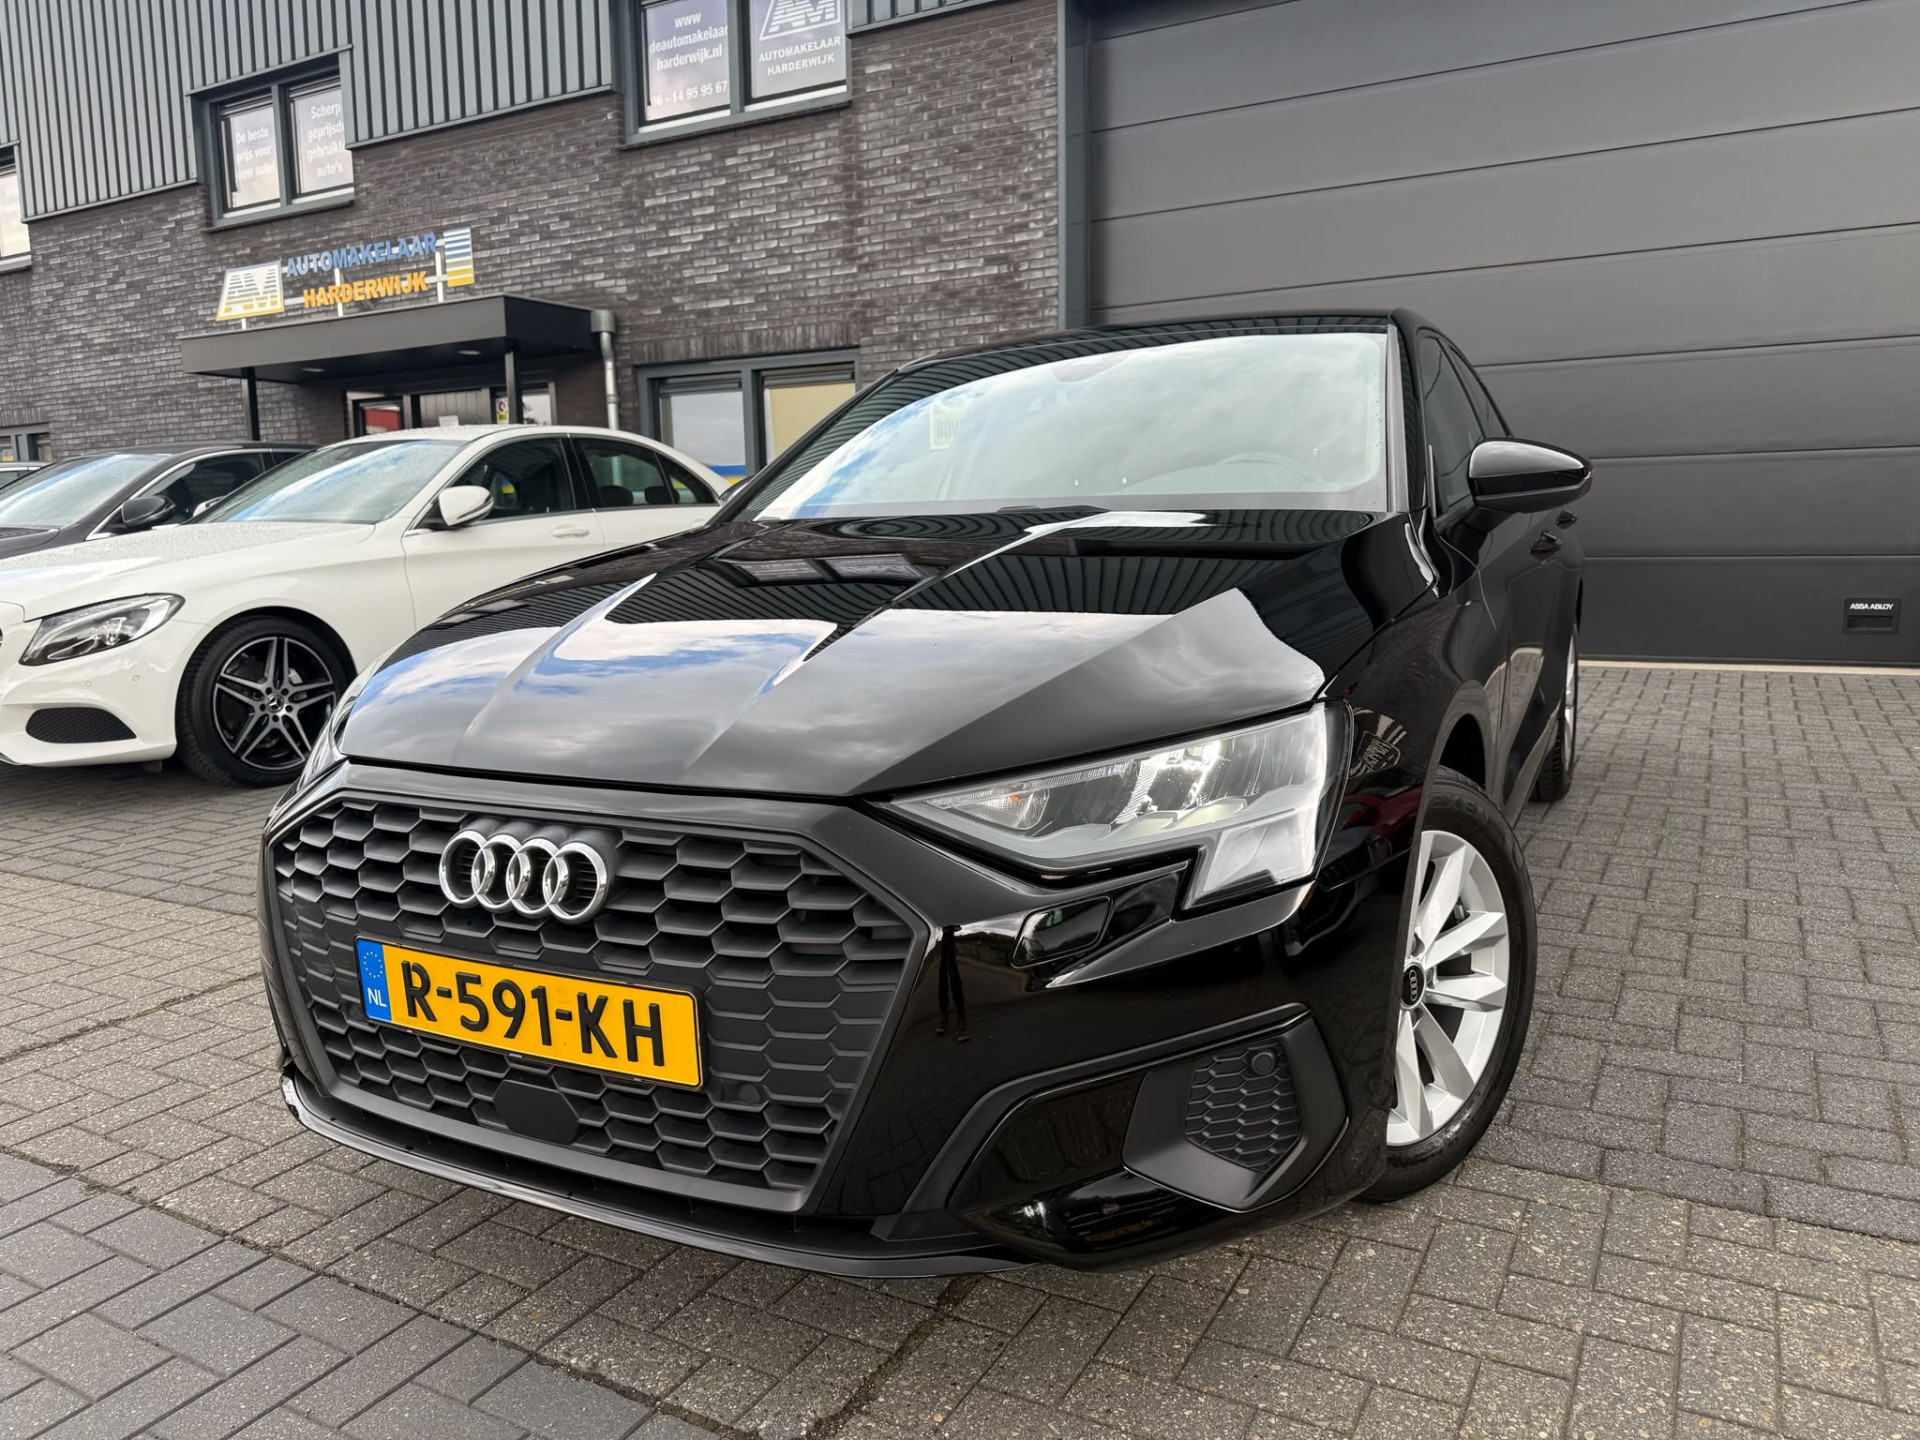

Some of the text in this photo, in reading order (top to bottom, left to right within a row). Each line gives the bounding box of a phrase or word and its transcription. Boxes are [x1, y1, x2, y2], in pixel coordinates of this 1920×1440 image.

[674, 12, 701, 28] www
[650, 25, 729, 53] deautomakelaar
[758, 36, 841, 63] AUTOMAKELAAR
[657, 44, 723, 71] harderwijk.nl
[767, 53, 835, 76] HARDERWIJK
[686, 86, 698, 100] 95
[700, 83, 713, 97] 95
[715, 80, 728, 94] 67
[311, 103, 341, 119] Scherp
[286, 232, 437, 277] AUTOMAKELAAR
[303, 271, 428, 308] HARDERWIJK
[367, 987, 387, 1008] NL
[401, 960, 665, 1067] R-591-KH
